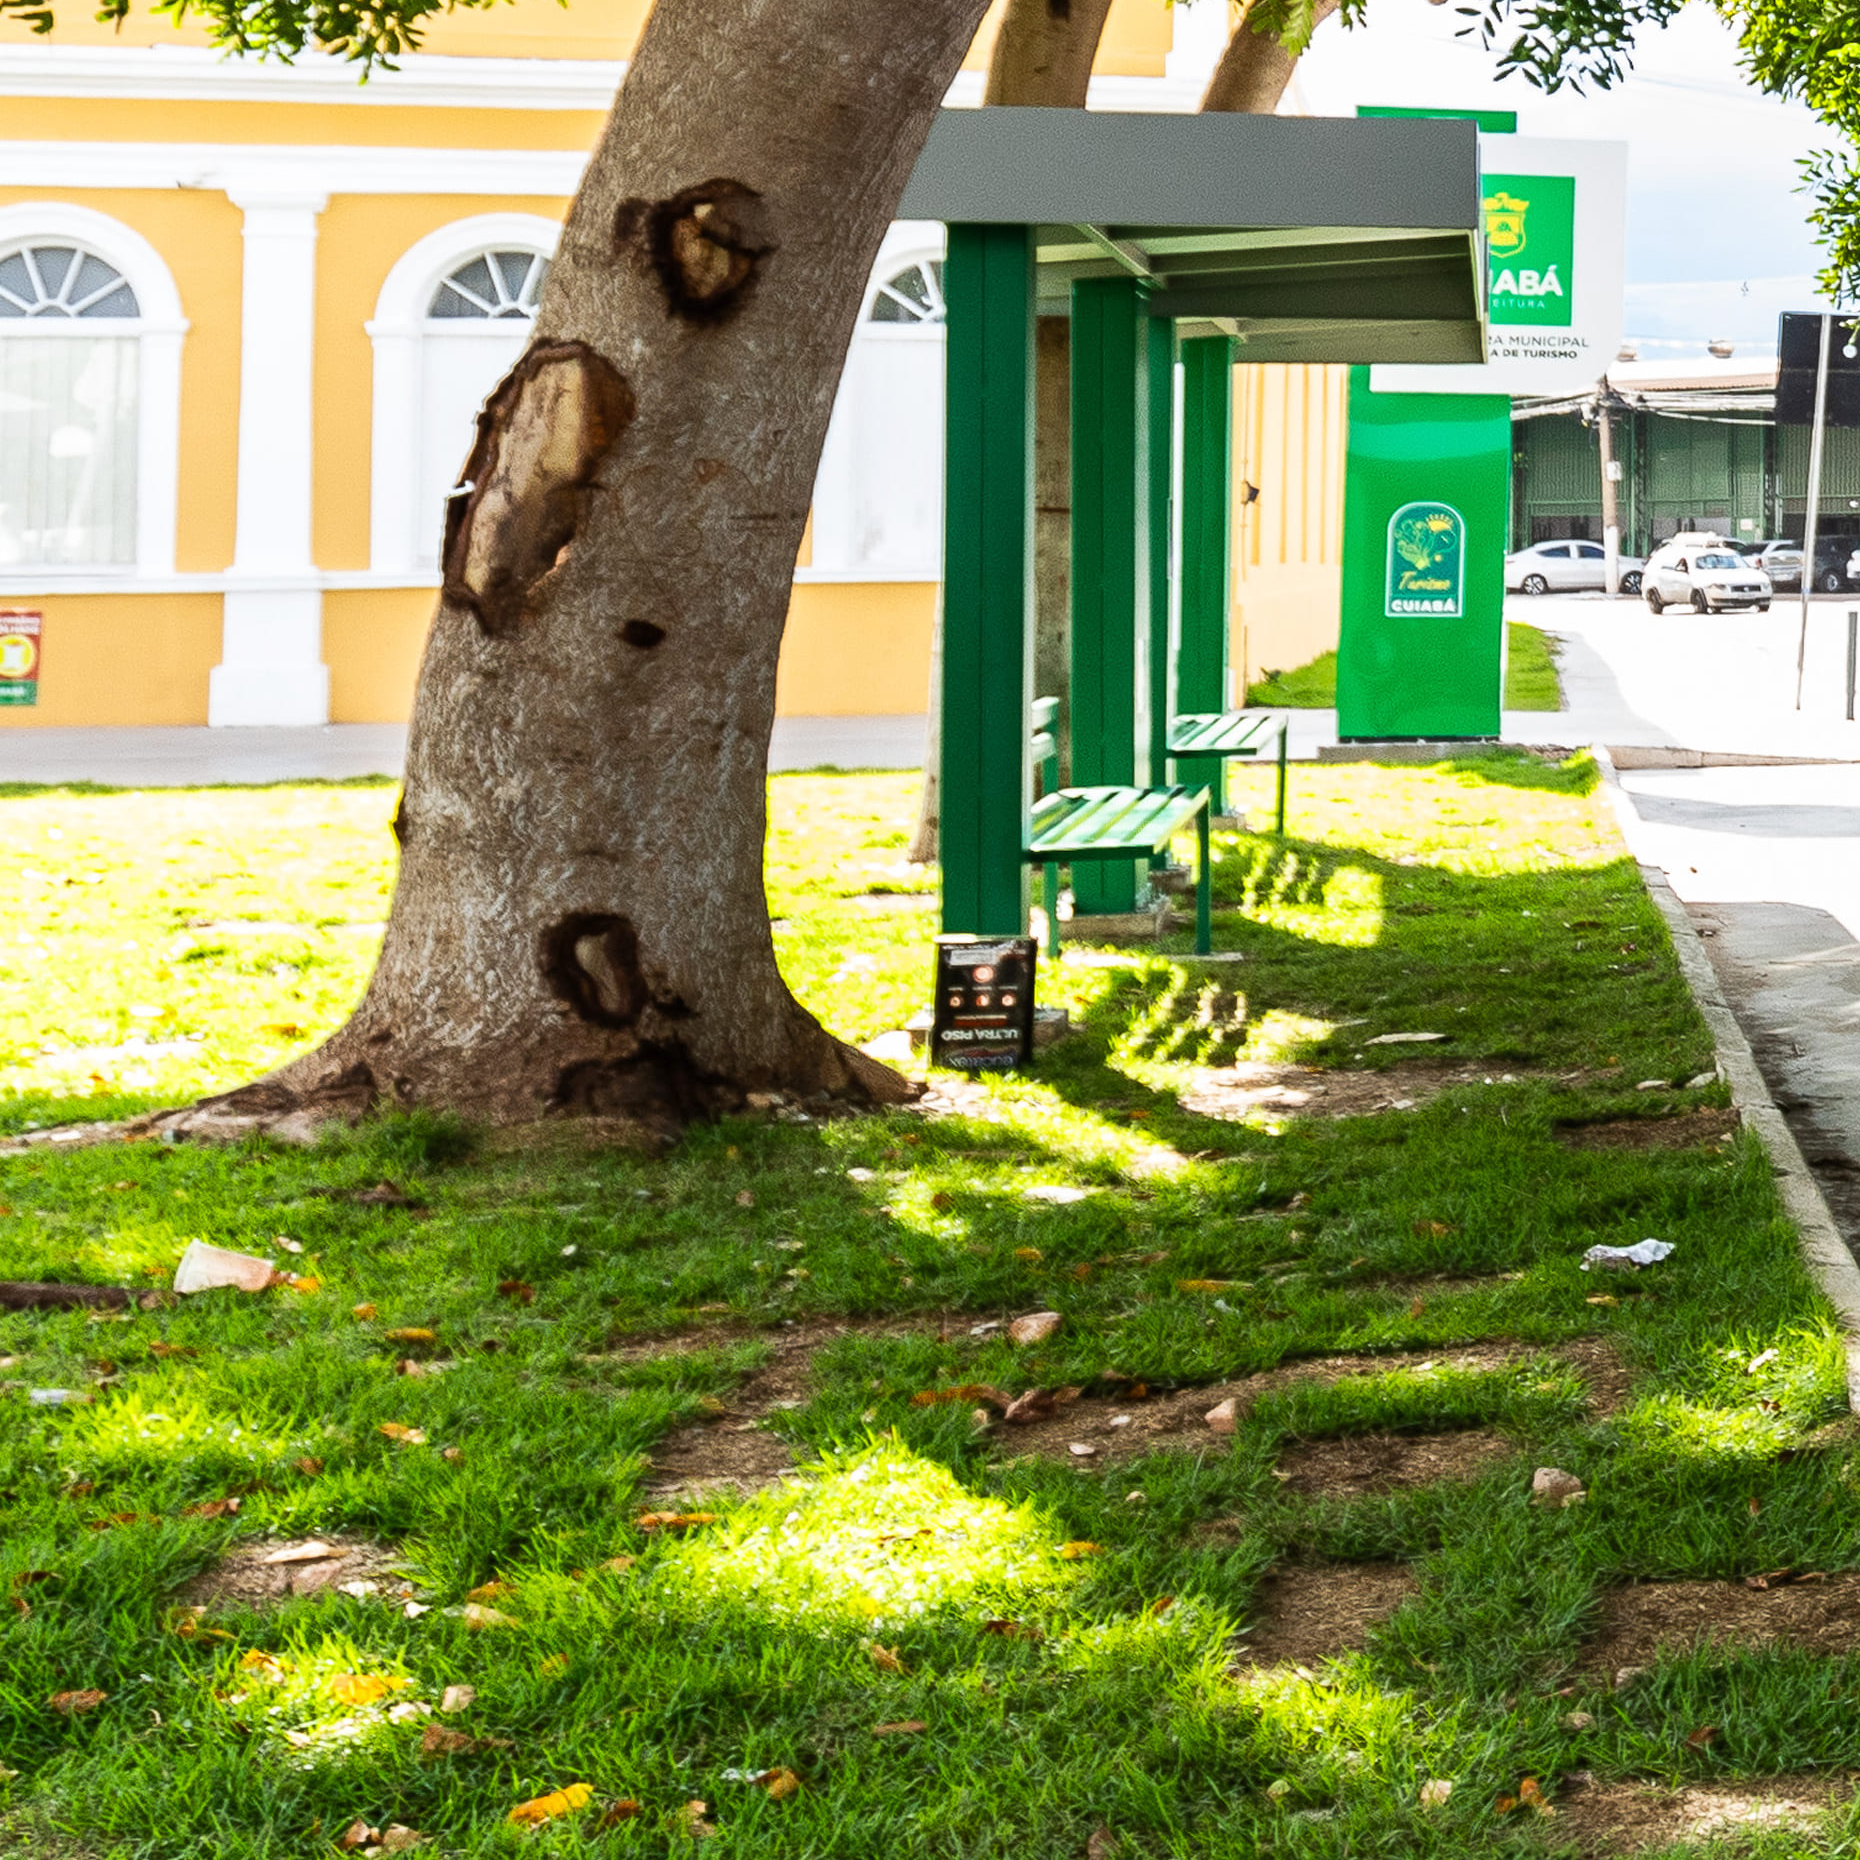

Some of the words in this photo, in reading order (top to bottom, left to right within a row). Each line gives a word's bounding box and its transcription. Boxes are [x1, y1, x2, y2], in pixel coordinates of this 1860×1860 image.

[1492, 298, 1546, 309] EITURA
[1509, 335, 1590, 348] MUNICIPAL
[1503, 348, 1519, 358] DE
[1524, 349, 1578, 360] TURISMO
[1391, 598, 1456, 613] CUIABÁ
[941, 1029, 973, 1042] PISO
[974, 1028, 1019, 1041] ULTRA
